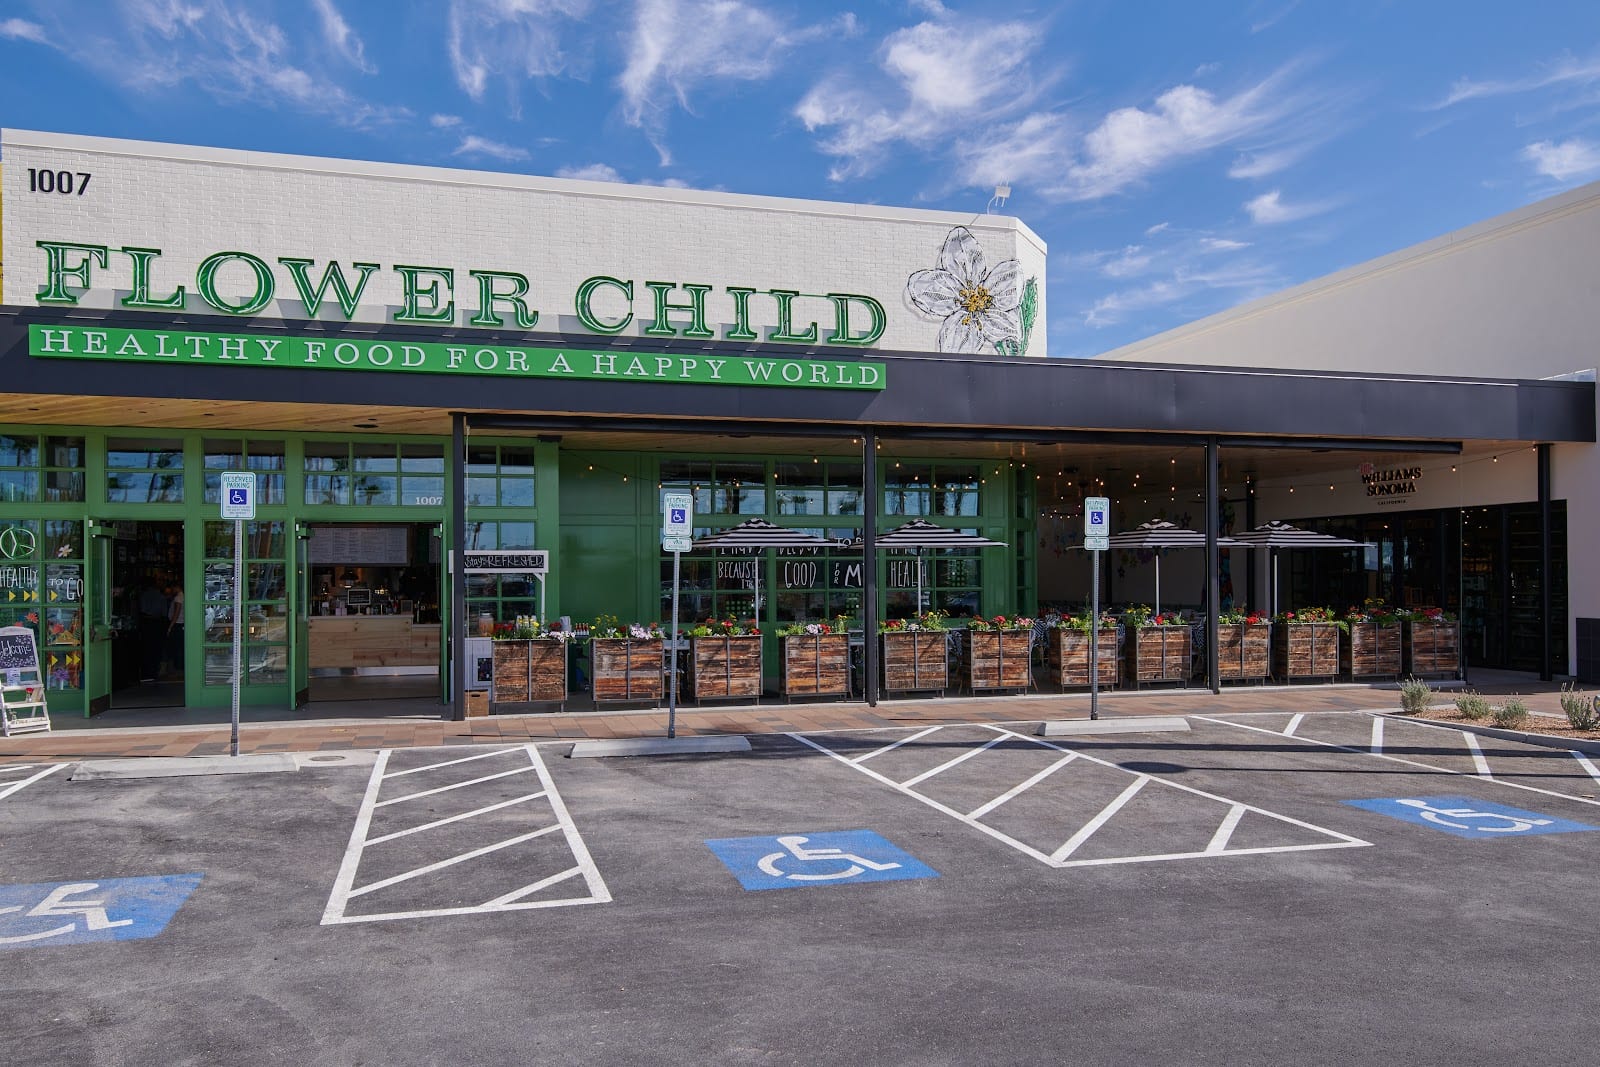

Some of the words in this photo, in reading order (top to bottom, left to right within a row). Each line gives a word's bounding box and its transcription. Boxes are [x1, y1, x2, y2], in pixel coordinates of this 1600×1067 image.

[28, 168, 92, 195] 1007
[36, 240, 539, 329] FLOWER
[575, 275, 887, 346] CHILD
[40, 329, 283, 362] HEALTHY
[304, 341, 426, 368] FOOD
[446, 348, 530, 373] FOR
[547, 352, 575, 374] A
[592, 354, 727, 380] HAPPY
[743, 361, 880, 386] WORLD
[1361, 467, 1422, 484] WILLIAMS
[1367, 482, 1417, 496] SONOMA
[416, 496, 443, 506] 1007
[0, 566, 38, 588] HEALTHY
[49, 578, 64, 586] TO
[66, 577, 84, 600] GO
[718, 561, 757, 579] BECAUSE
[784, 561, 817, 589] GOOD
[844, 562, 864, 588] M
